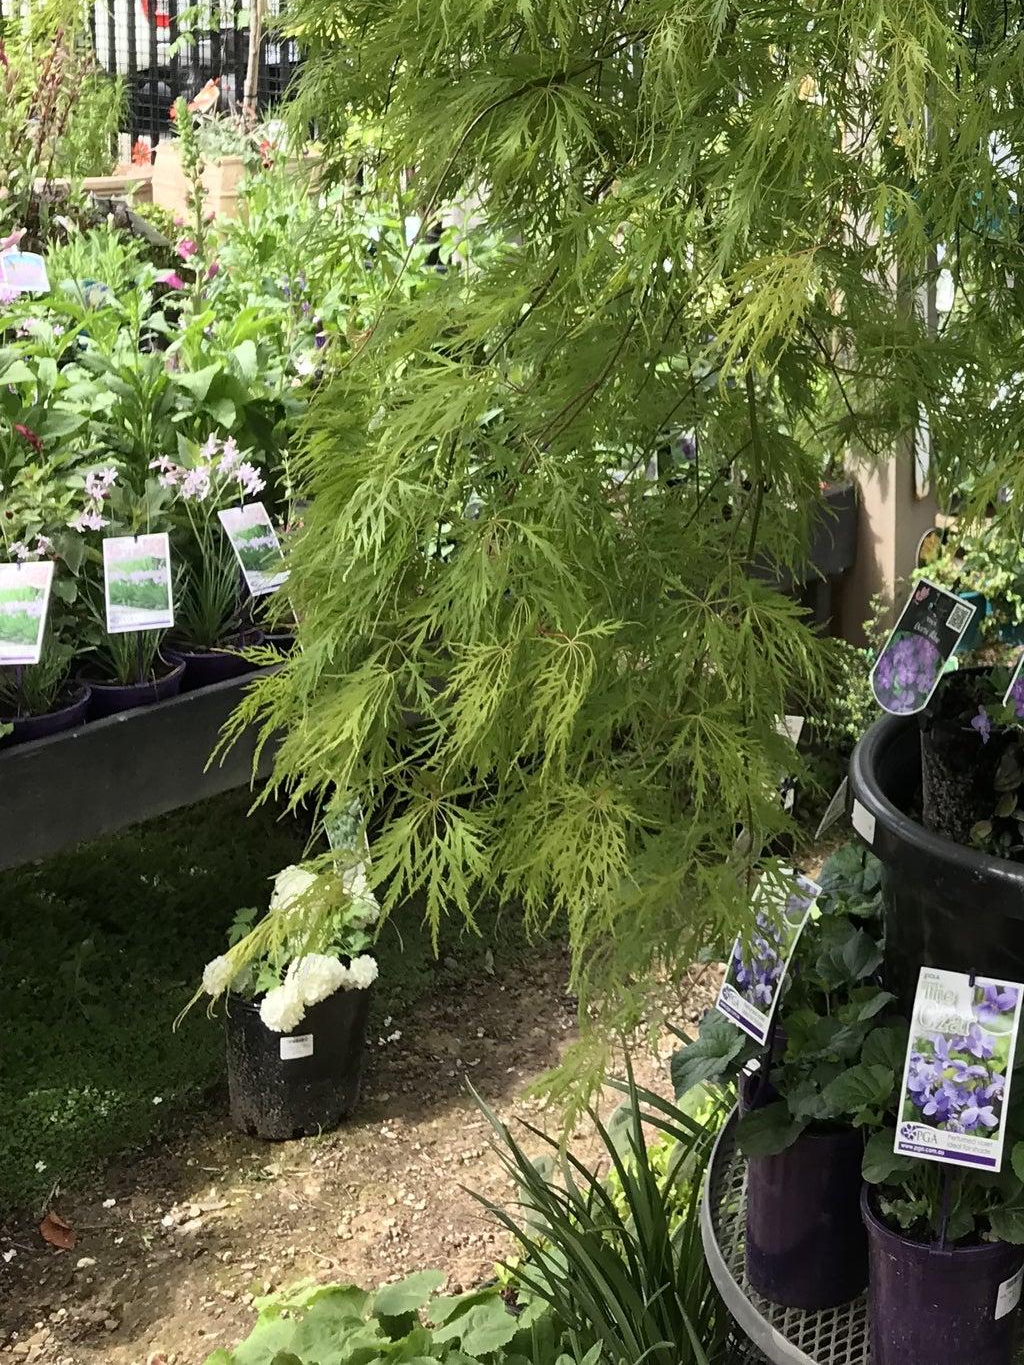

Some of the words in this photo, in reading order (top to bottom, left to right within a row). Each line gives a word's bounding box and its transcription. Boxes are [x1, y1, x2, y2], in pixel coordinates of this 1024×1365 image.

[922, 982, 957, 1005] The
[917, 1002, 970, 1036] Czar
[916, 1130, 938, 1145] PGA
